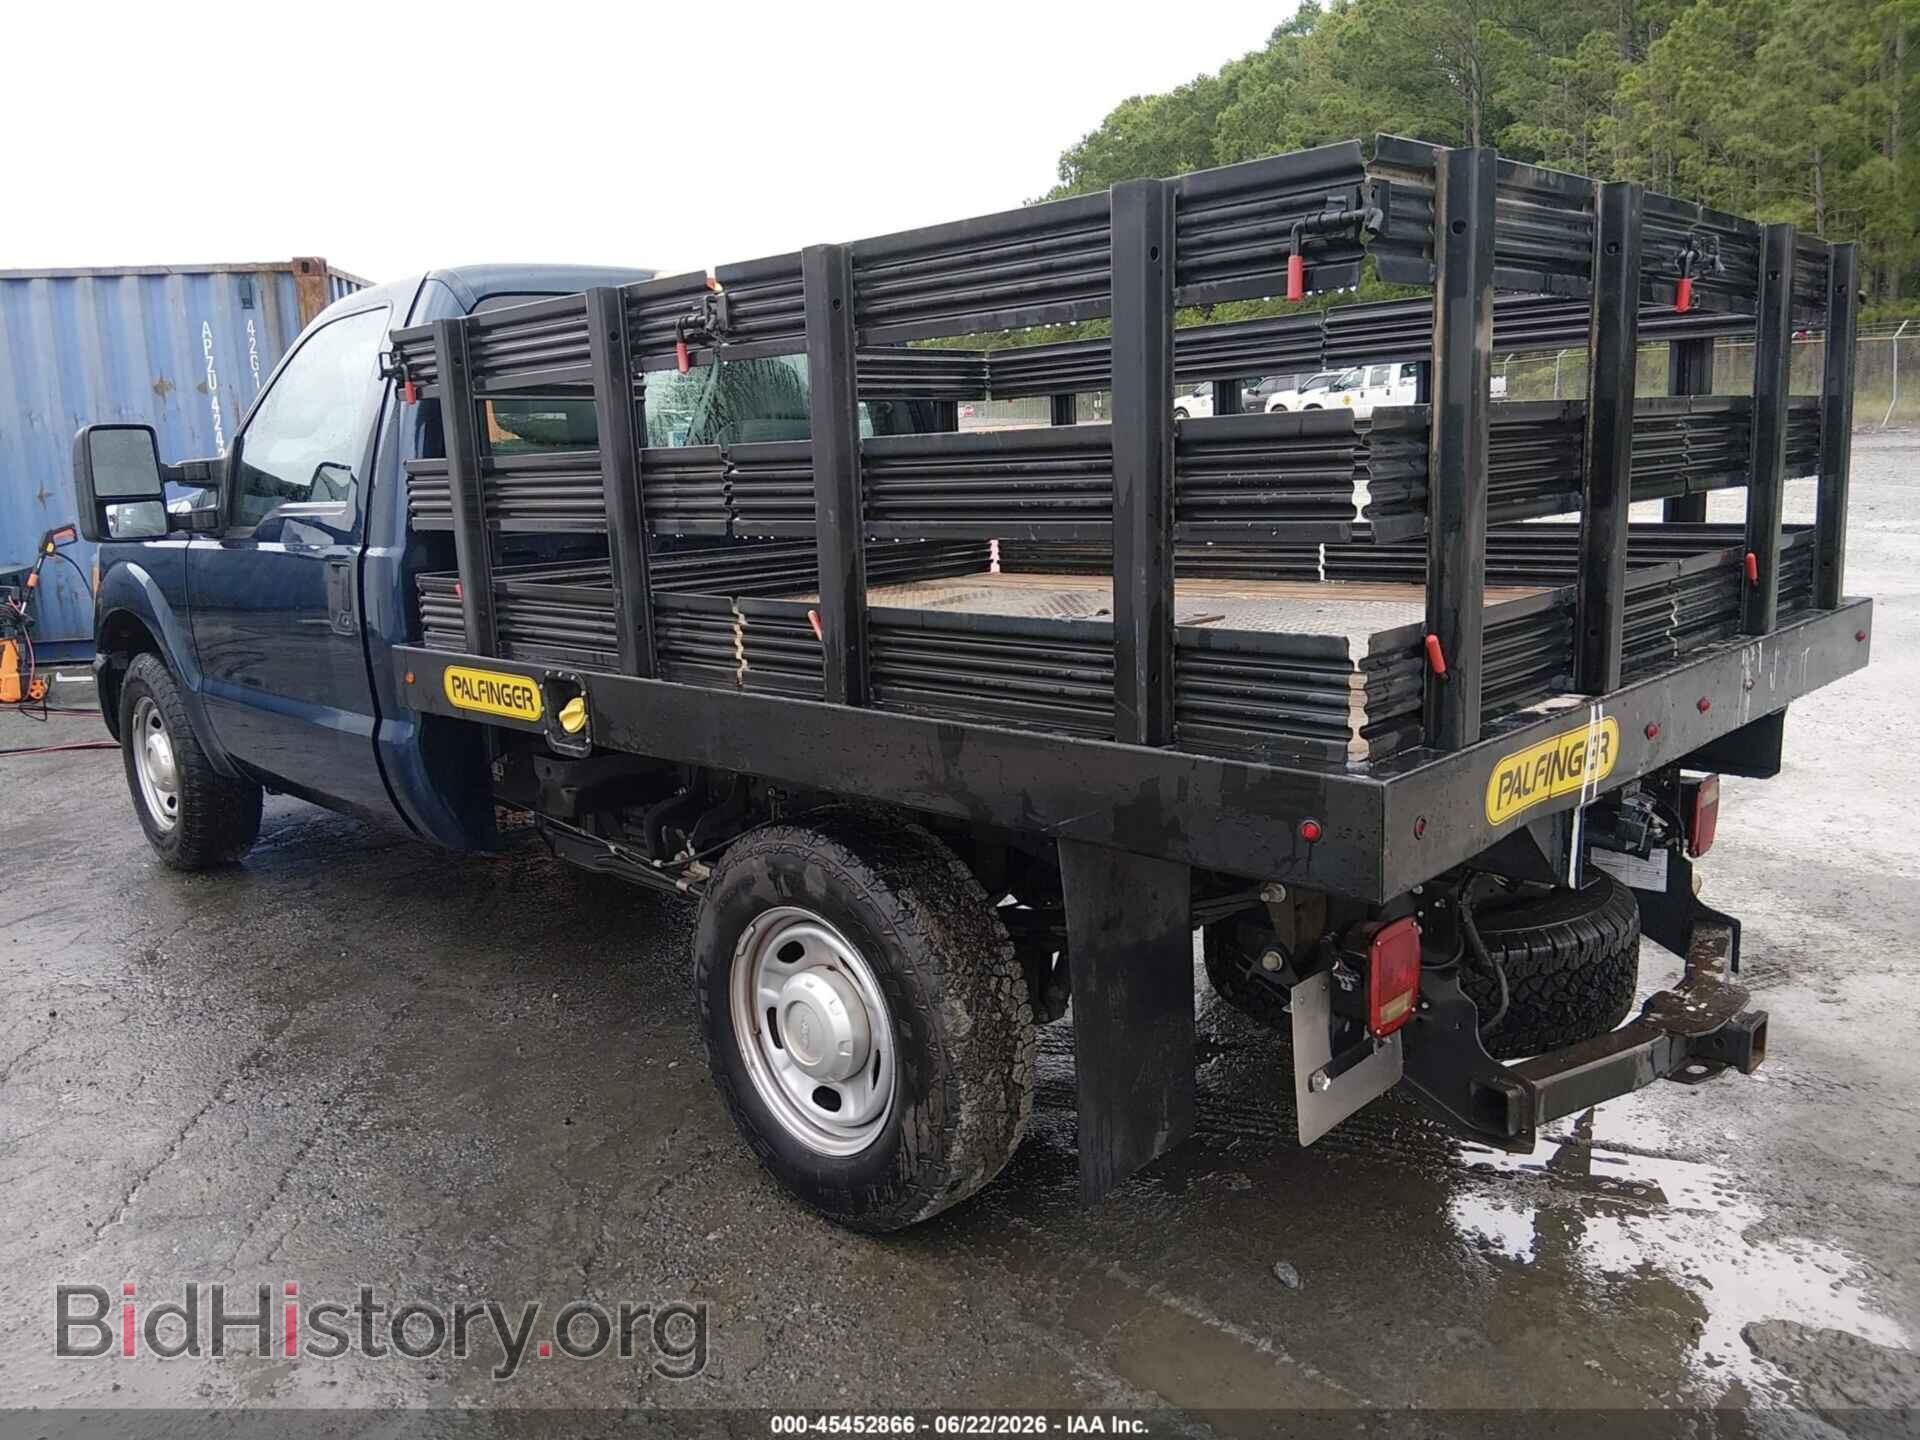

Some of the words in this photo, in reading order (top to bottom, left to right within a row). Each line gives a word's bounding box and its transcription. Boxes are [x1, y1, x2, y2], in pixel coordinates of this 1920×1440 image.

[202, 320, 217, 390] APZU
[247, 319, 260, 389] 42G1
[451, 674, 535, 712] PALFINGER
[1496, 731, 1611, 811] PALFINGER
